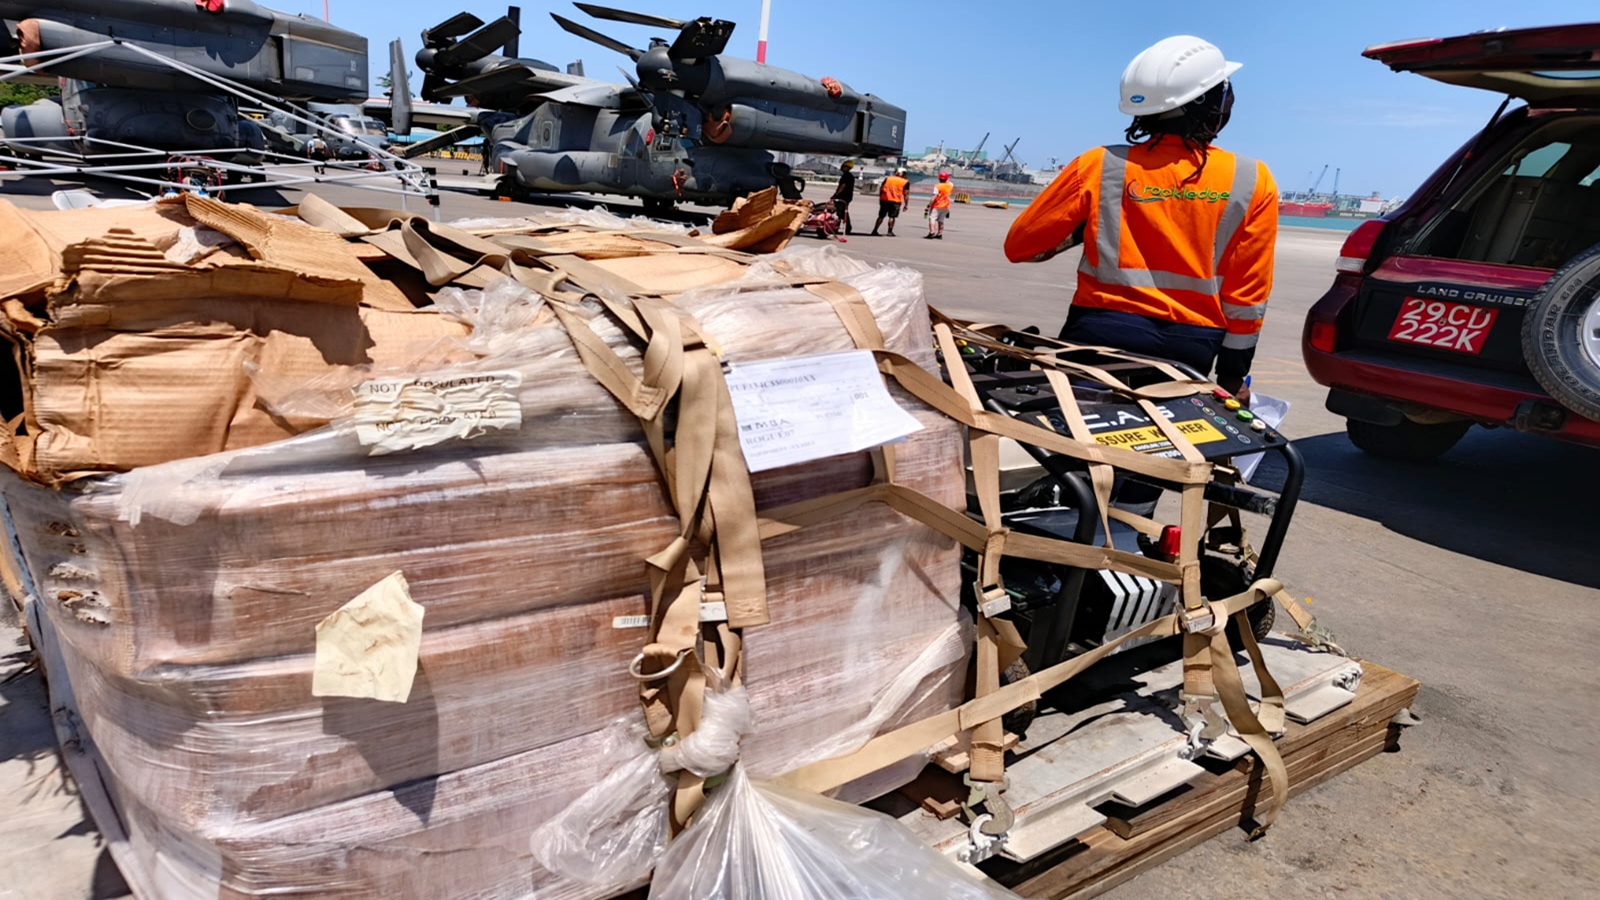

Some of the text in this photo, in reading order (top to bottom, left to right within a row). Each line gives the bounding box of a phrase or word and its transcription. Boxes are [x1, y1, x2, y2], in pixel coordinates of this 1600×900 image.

[1416, 285, 1460, 298] LAND
[1394, 319, 1482, 352] 222K
[369, 382, 400, 395] NOT
[1096, 432, 1147, 446] SSURE
[1148, 423, 1208, 439] WHER
